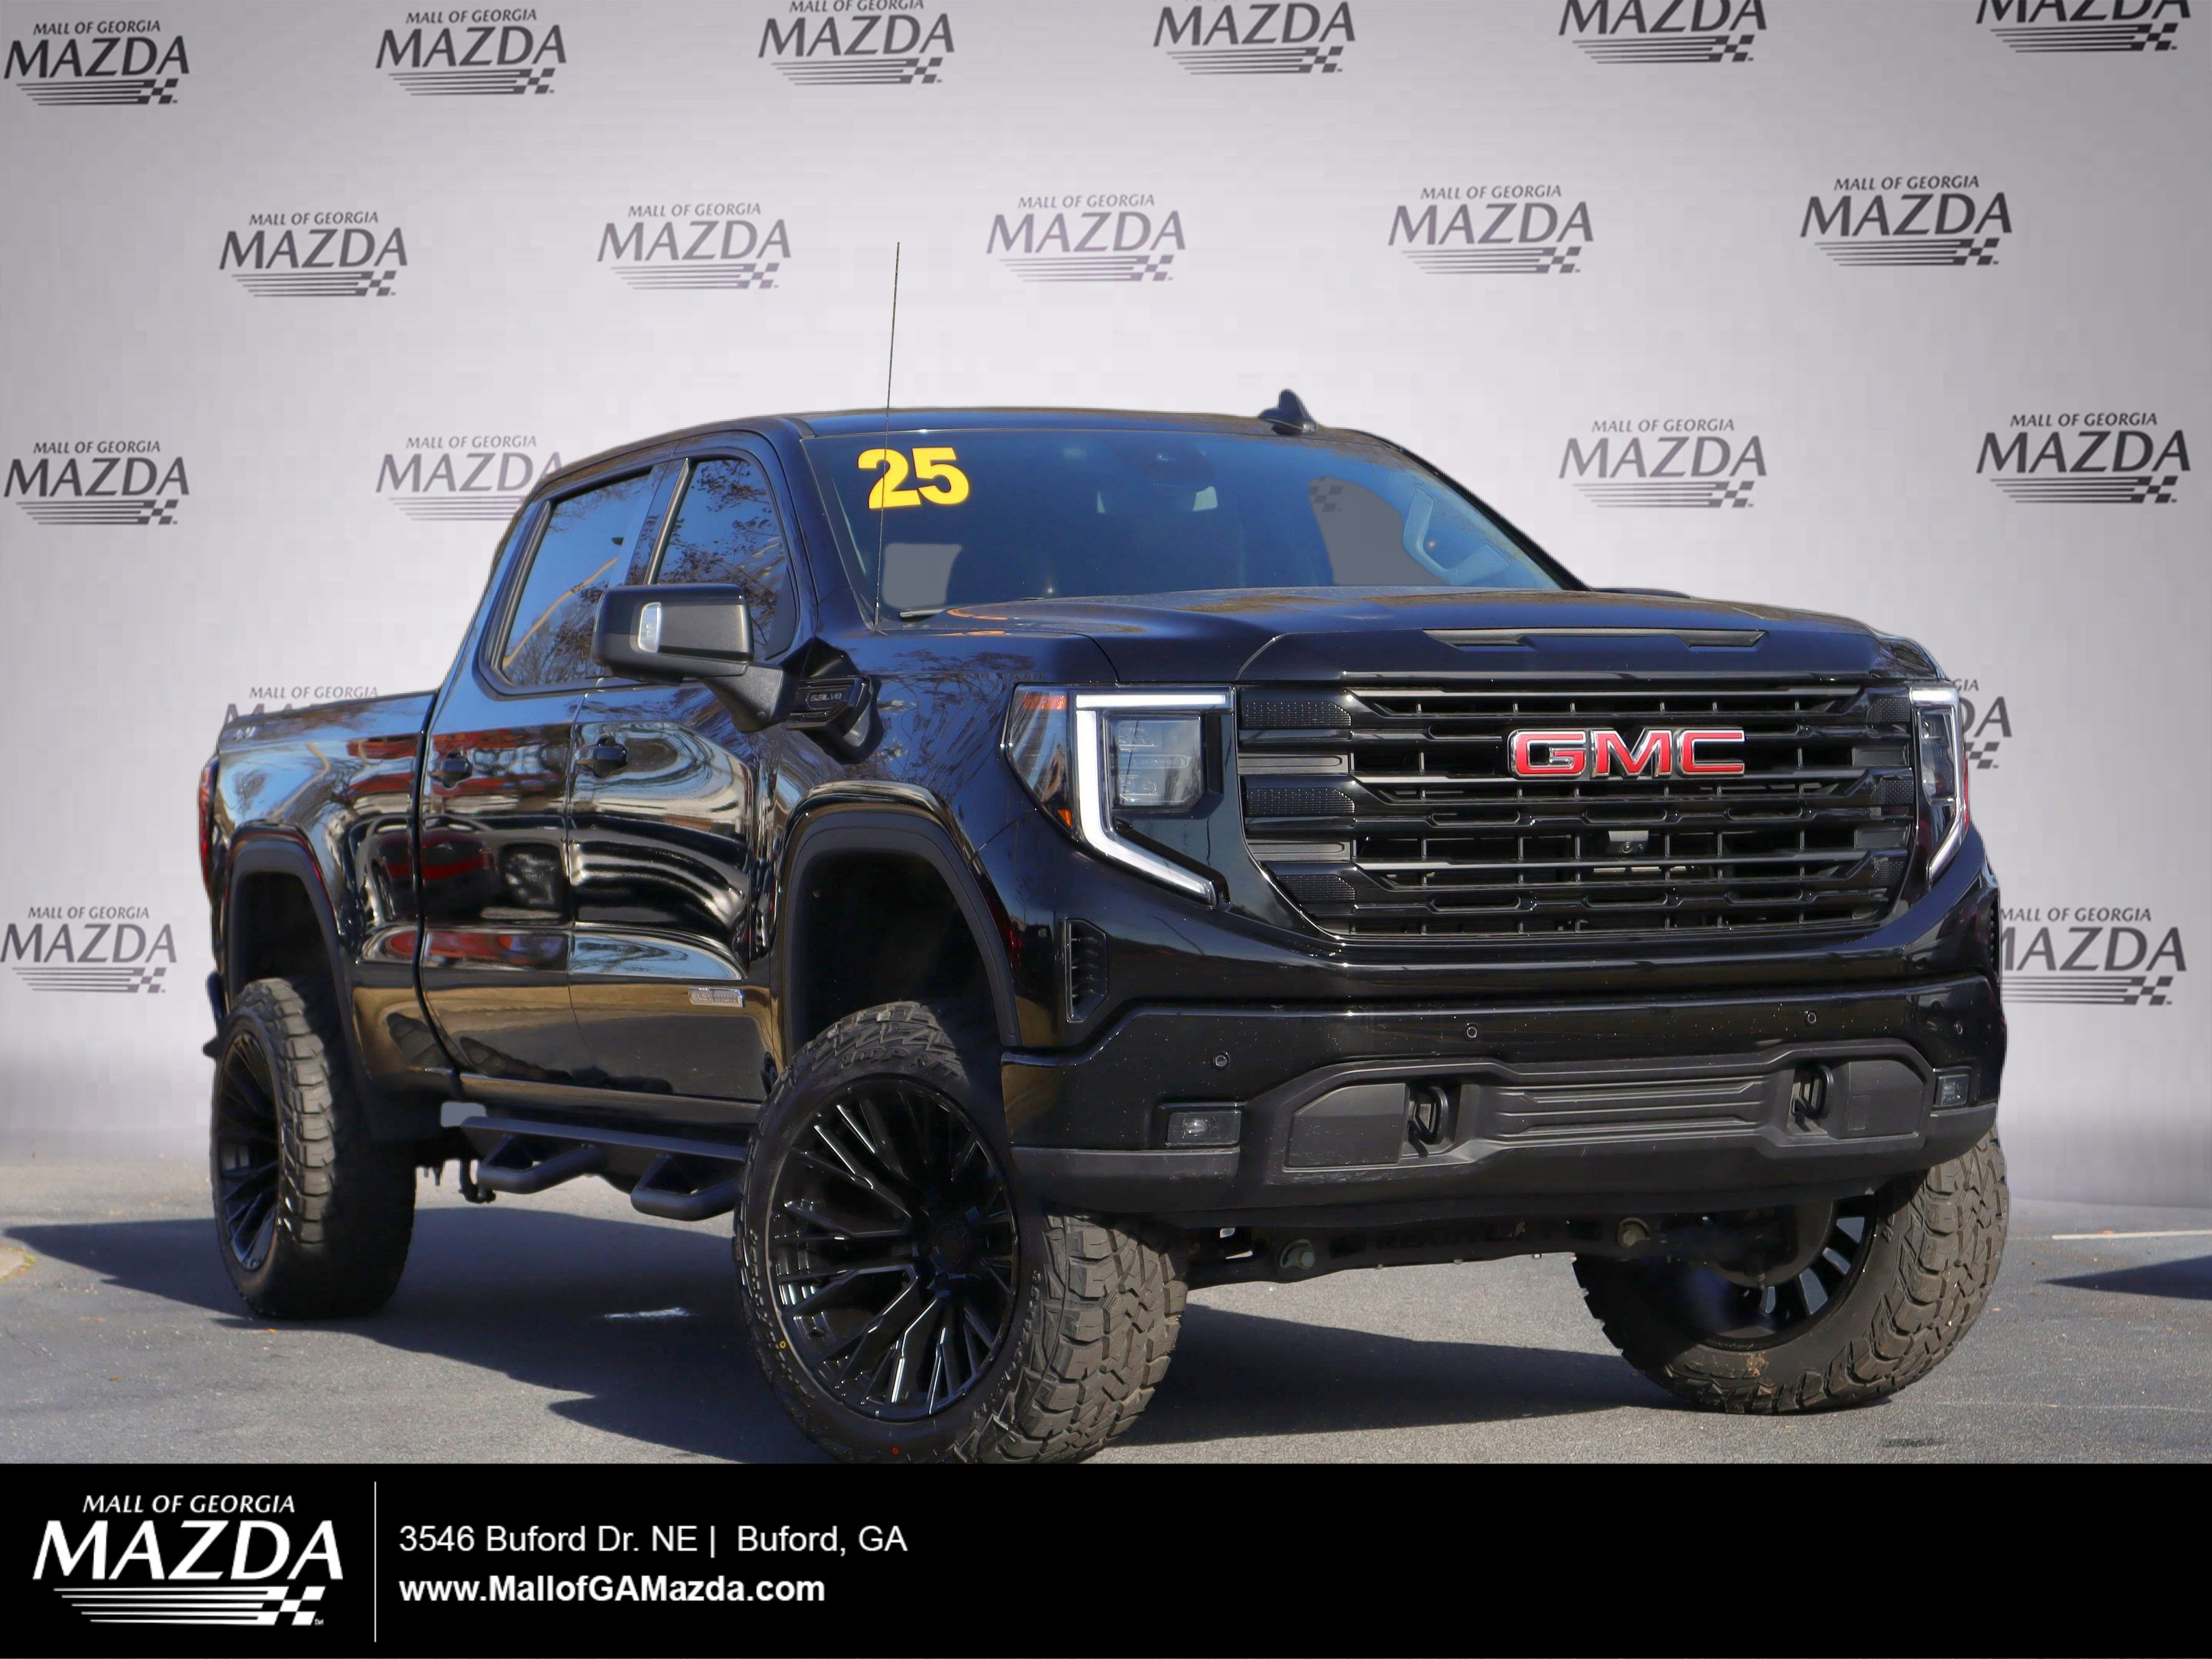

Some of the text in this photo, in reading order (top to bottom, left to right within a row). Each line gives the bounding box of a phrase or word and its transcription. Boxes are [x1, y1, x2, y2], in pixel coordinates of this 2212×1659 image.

[406, 9, 537, 24] MALL OF GEORGIA
[790, 0, 924, 12] MALL OF GEORGIA
[1559, 0, 1767, 35] MAZDA
[33, 20, 161, 35] MALL OF GEORGIA
[758, 13, 955, 58] MAZDA
[1153, 1, 1356, 47] MAZDA
[4, 35, 189, 79] MAZDA
[376, 24, 566, 69] MAZDA
[1420, 184, 1562, 199] MALL OF GEORGIA
[1834, 175, 1979, 191] MALL OF GEORGIA
[249, 212, 378, 225] MALL OF GEORGIA
[628, 202, 761, 217] MALL OF GEORGIA
[1018, 194, 1155, 209] MALL OF GEORGIA
[1800, 192, 2012, 237] MAZDA
[597, 219, 791, 262] MAZDA
[986, 210, 1186, 254] MAZDA
[1388, 201, 1594, 245] MAZDA
[219, 227, 407, 270] MAZDA
[1592, 418, 1735, 432] MALL OF GEORGIA
[2010, 412, 2157, 427] MALL OF GEORGIA
[33, 440, 160, 454] MALL OF GEORGIA
[405, 435, 537, 449] MALL OF GEORGIA
[1559, 435, 1767, 478] MAZDA
[1976, 429, 2191, 473] MAZDA
[3, 456, 189, 498] MAZDA
[857, 446, 970, 509] 25
[249, 686, 378, 699] MALL OF GEORGIA
[1508, 729, 1745, 778] GMC
[27, 906, 149, 919] MALL OF GEORGIA
[2000, 907, 2152, 922] MALL OF GEORGIA
[0, 923, 176, 963] MAZDA
